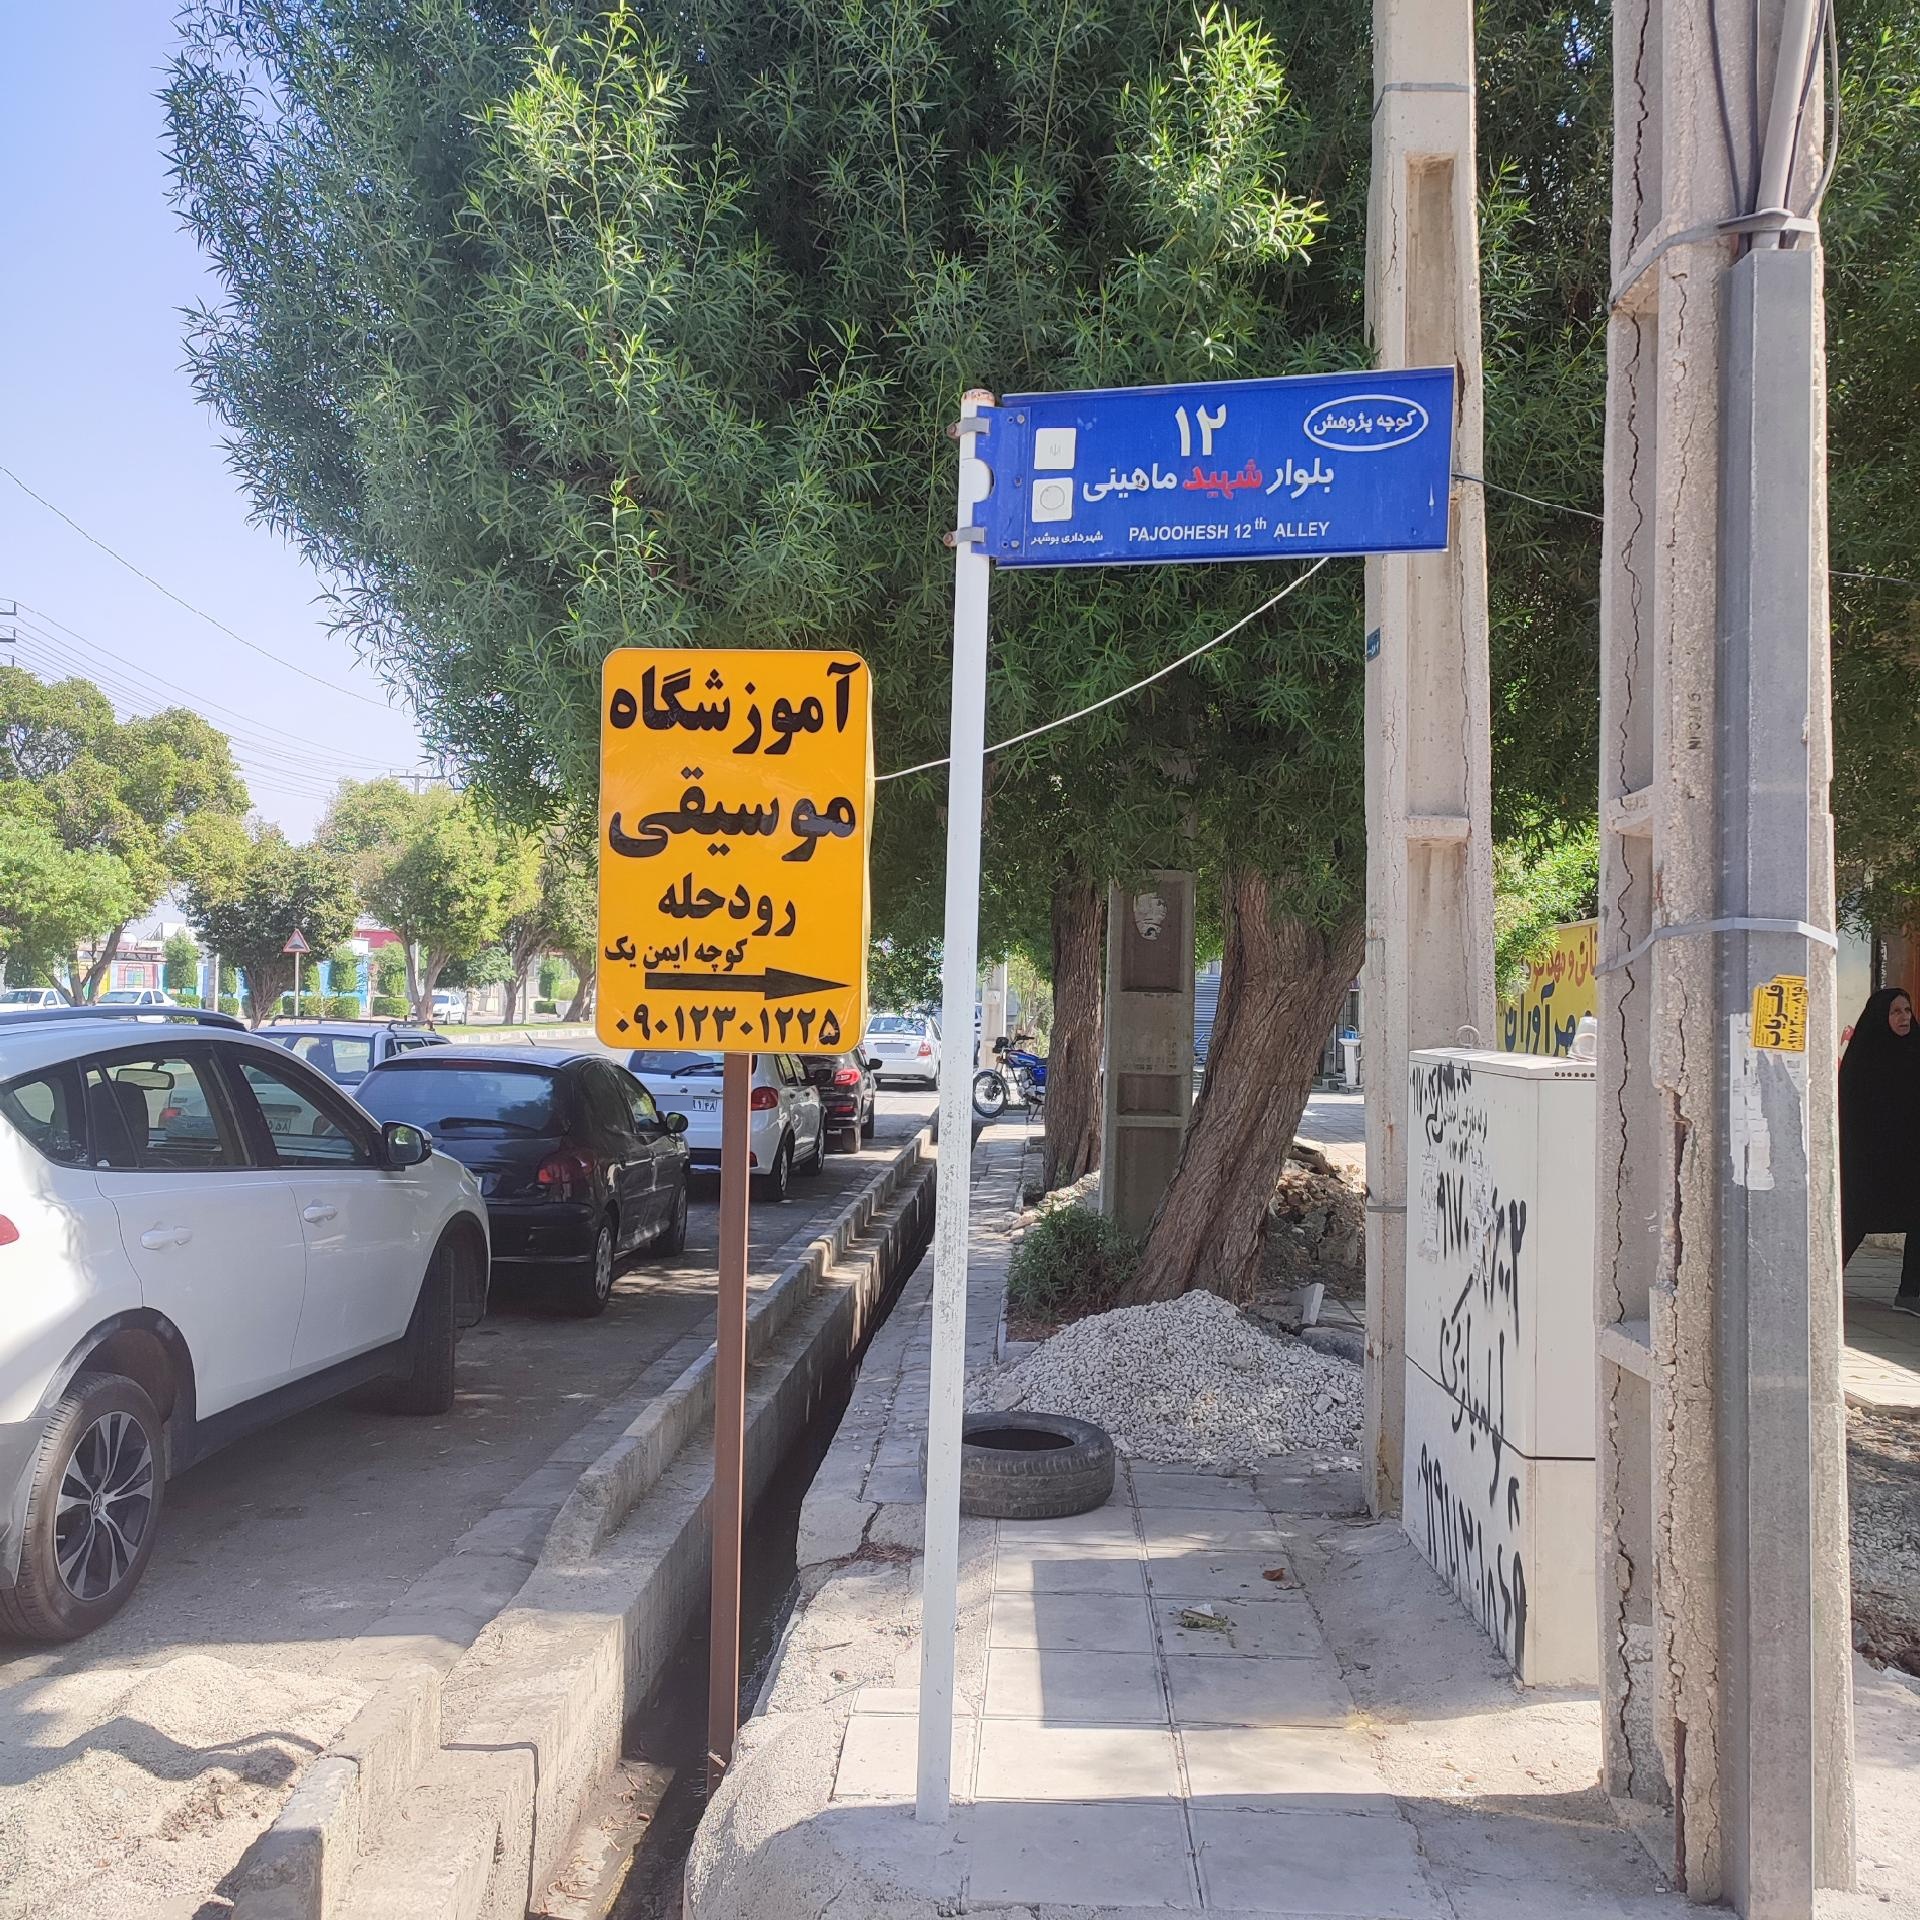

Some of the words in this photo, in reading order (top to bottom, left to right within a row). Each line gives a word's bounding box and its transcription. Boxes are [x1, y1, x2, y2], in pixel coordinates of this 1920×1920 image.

[1174, 404, 1226, 457] ۱۲
[1313, 411, 1373, 436] پژوهش
[1376, 409, 1417, 433] کوچه
[1082, 462, 1177, 503] ماهینی
[1182, 458, 1264, 500] شهید
[1265, 458, 1334, 498] بلوار
[1030, 532, 1060, 546] بوشهر
[1061, 530, 1104, 544] شهرداری
[1128, 524, 1229, 542] PAJOOHESH
[1273, 521, 1331, 539] ALLEY
[609, 661, 862, 755] آموزشگاه
[608, 766, 857, 862] موسیقی
[604, 936, 637, 969] یک
[642, 937, 689, 971] ایمن
[694, 938, 748, 973] کوچه
[615, 1004, 842, 1046] ۰۹۰۱۲۳۰۱۲۲۵
[1764, 985, 1788, 1047] فلزیاب
